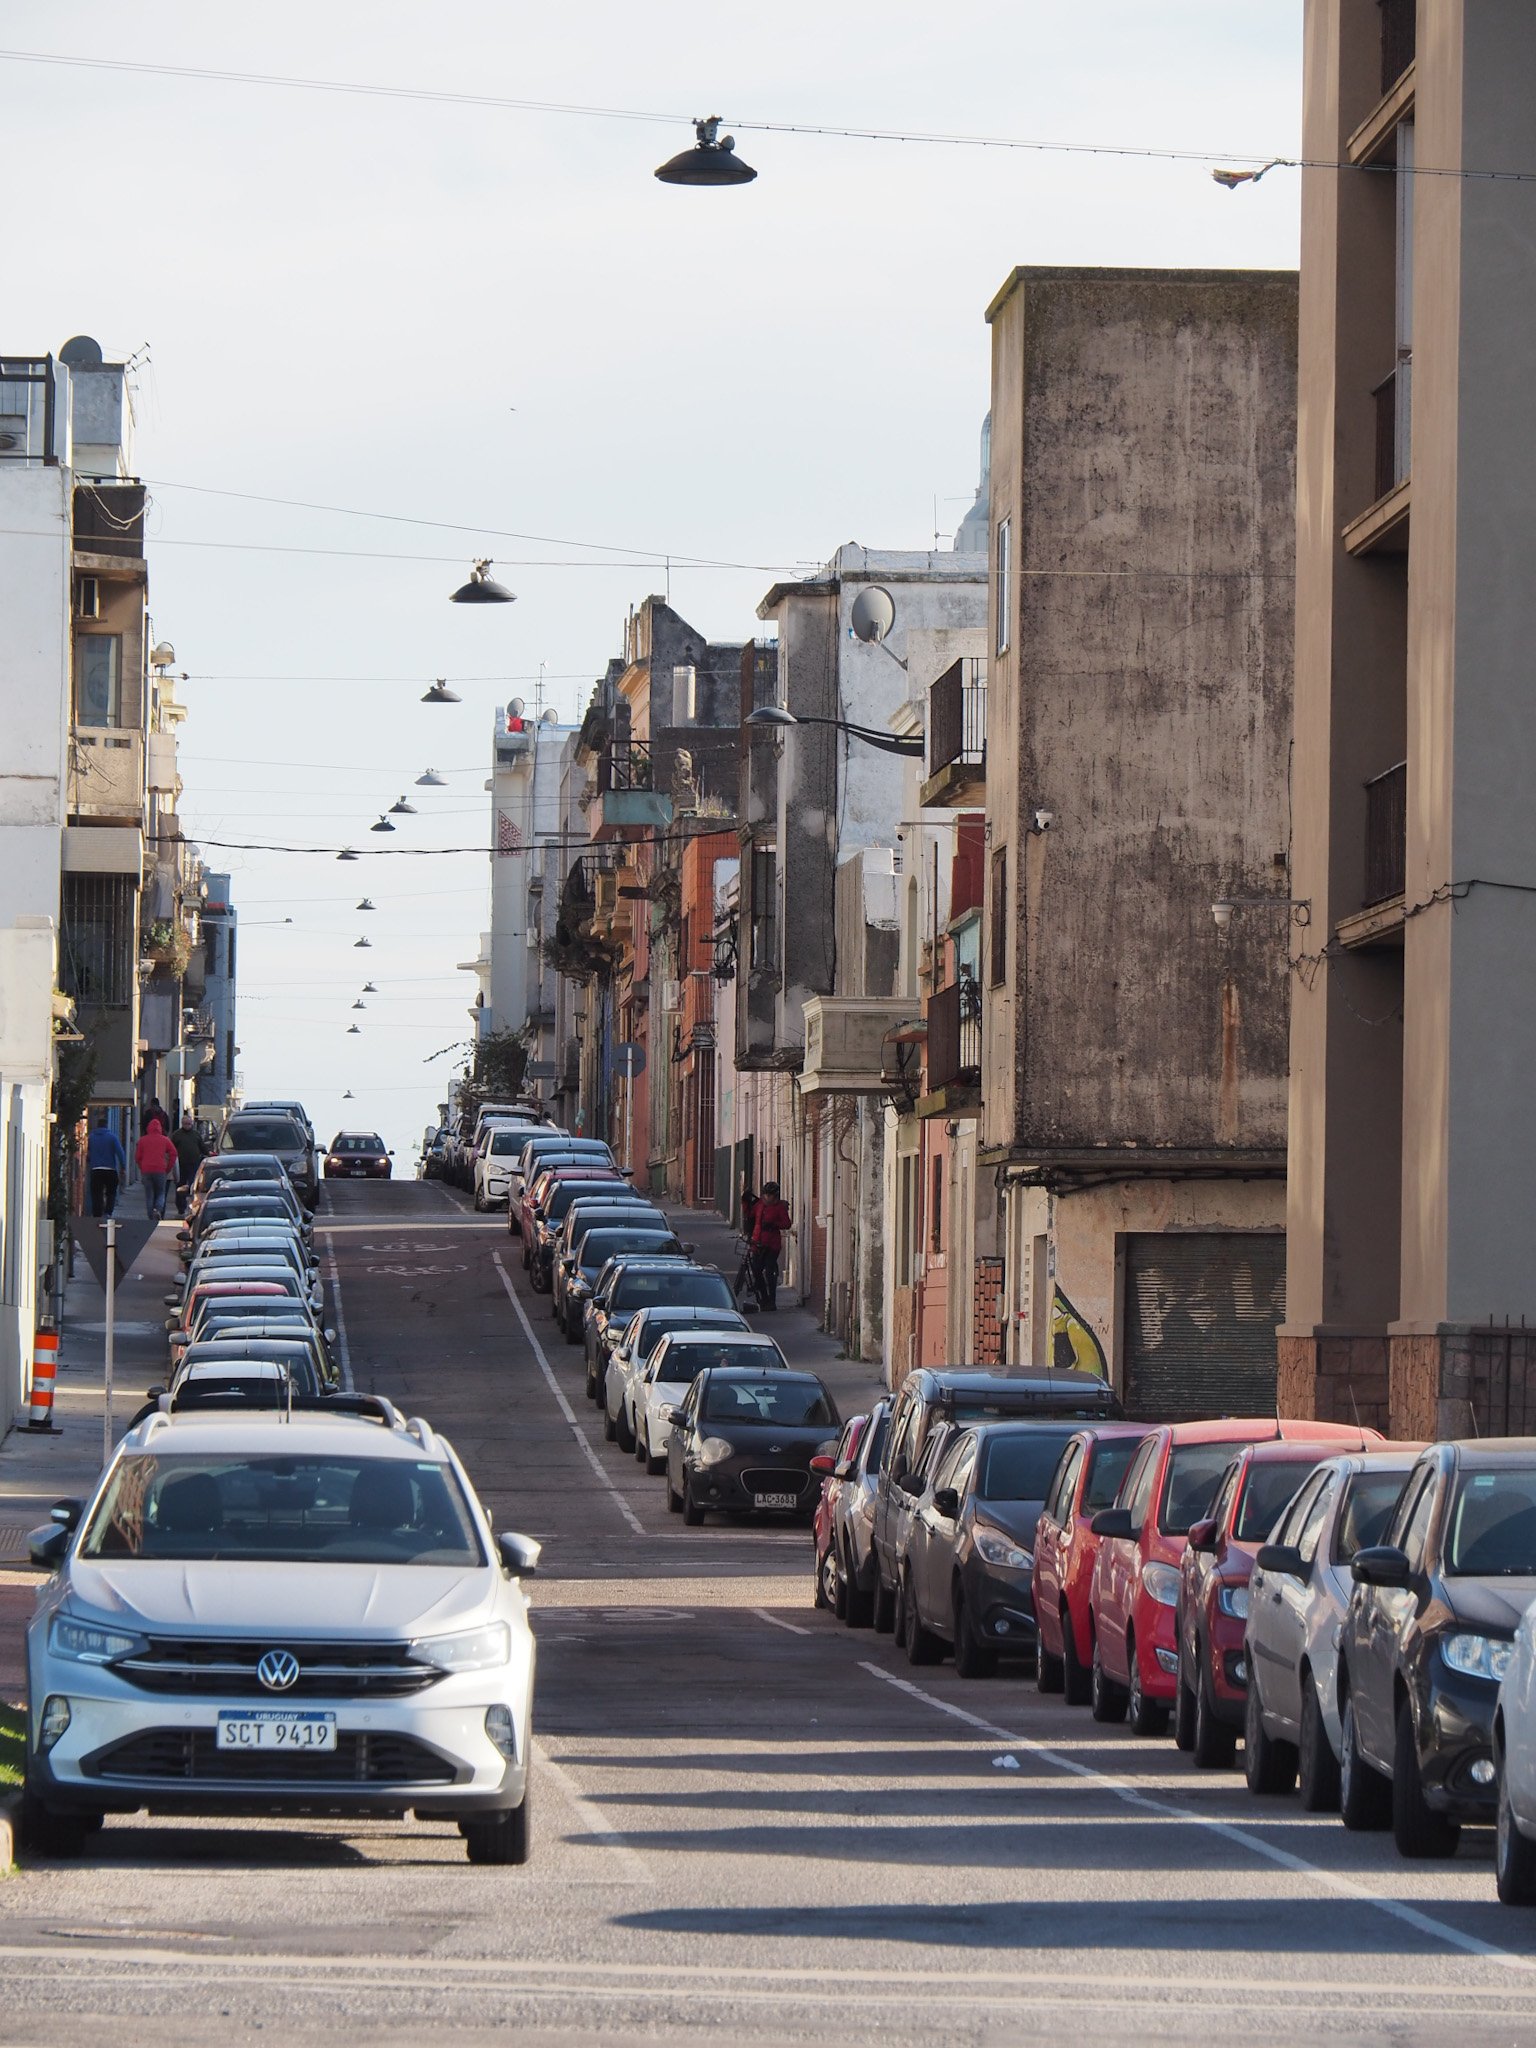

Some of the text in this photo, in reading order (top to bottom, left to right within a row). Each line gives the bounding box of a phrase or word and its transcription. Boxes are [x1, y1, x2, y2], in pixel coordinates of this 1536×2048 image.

[255, 1712, 299, 1721] URUGUAY
[225, 1723, 328, 1745] SCT 9419
